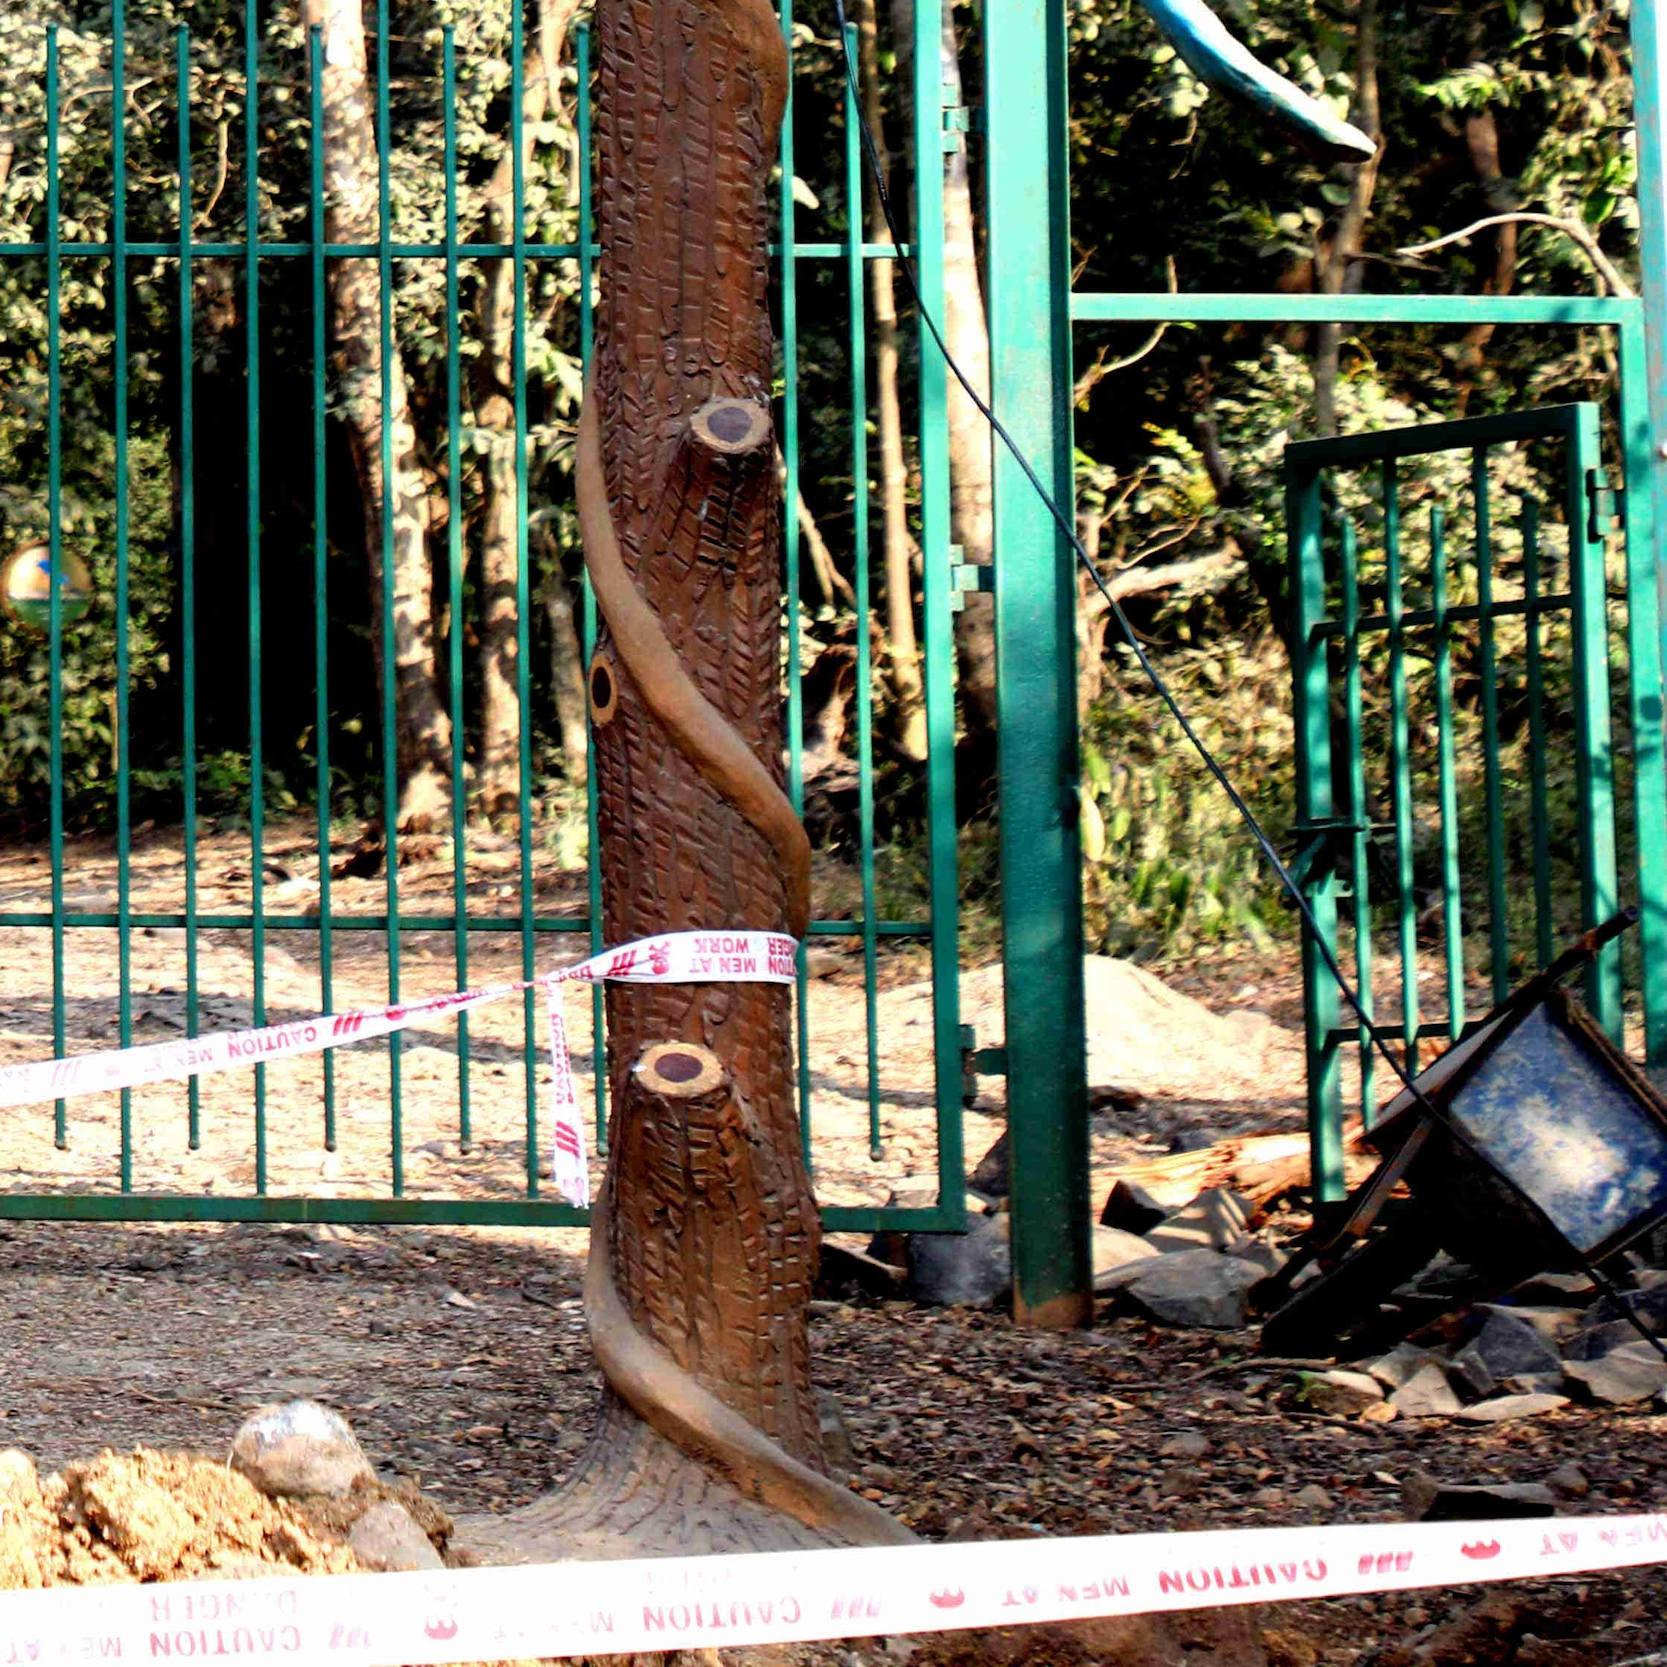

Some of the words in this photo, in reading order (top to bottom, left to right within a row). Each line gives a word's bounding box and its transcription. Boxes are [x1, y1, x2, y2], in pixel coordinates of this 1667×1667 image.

[694, 937, 749, 953] WORK
[689, 958, 711, 973] AT
[719, 958, 756, 973] MEN
[227, 1025, 318, 1057] CAUTION
[643, 1600, 802, 1631] CAUTION
[149, 1626, 301, 1657] CAUTION
